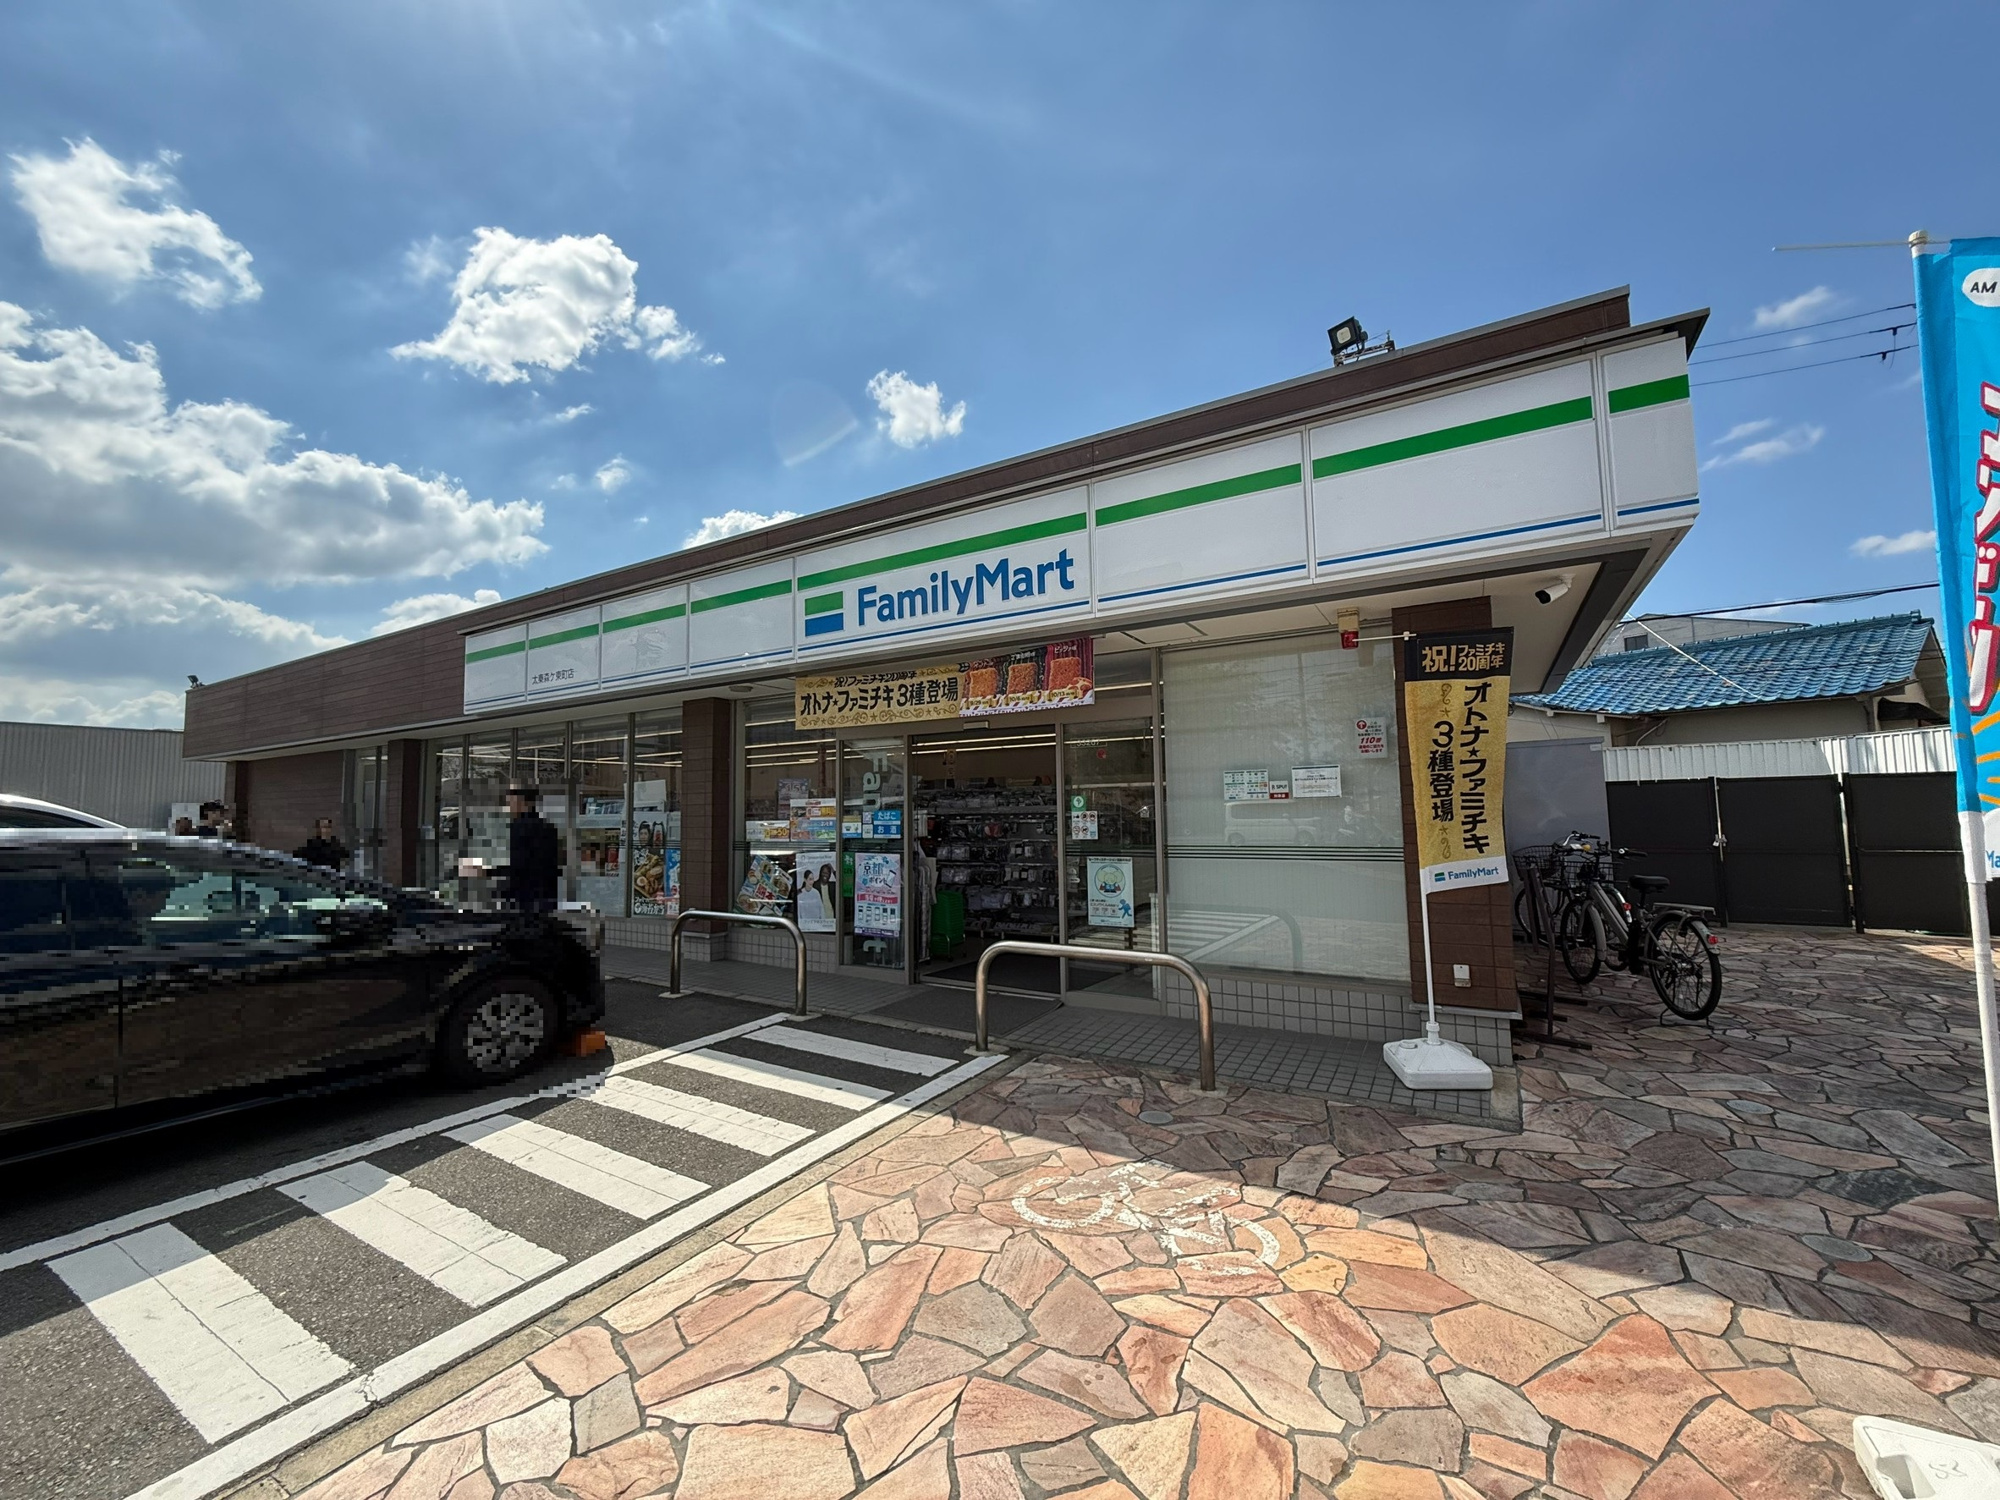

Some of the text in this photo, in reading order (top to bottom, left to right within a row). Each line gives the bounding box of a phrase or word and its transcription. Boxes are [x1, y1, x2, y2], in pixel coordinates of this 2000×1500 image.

[858, 548, 1075, 626] FamilyMart
[1458, 654, 1505, 672] 20周年
[877, 811, 897, 820] たばこ
[863, 862, 884, 876] 京都
[1448, 866, 1500, 881] FamilyMart
